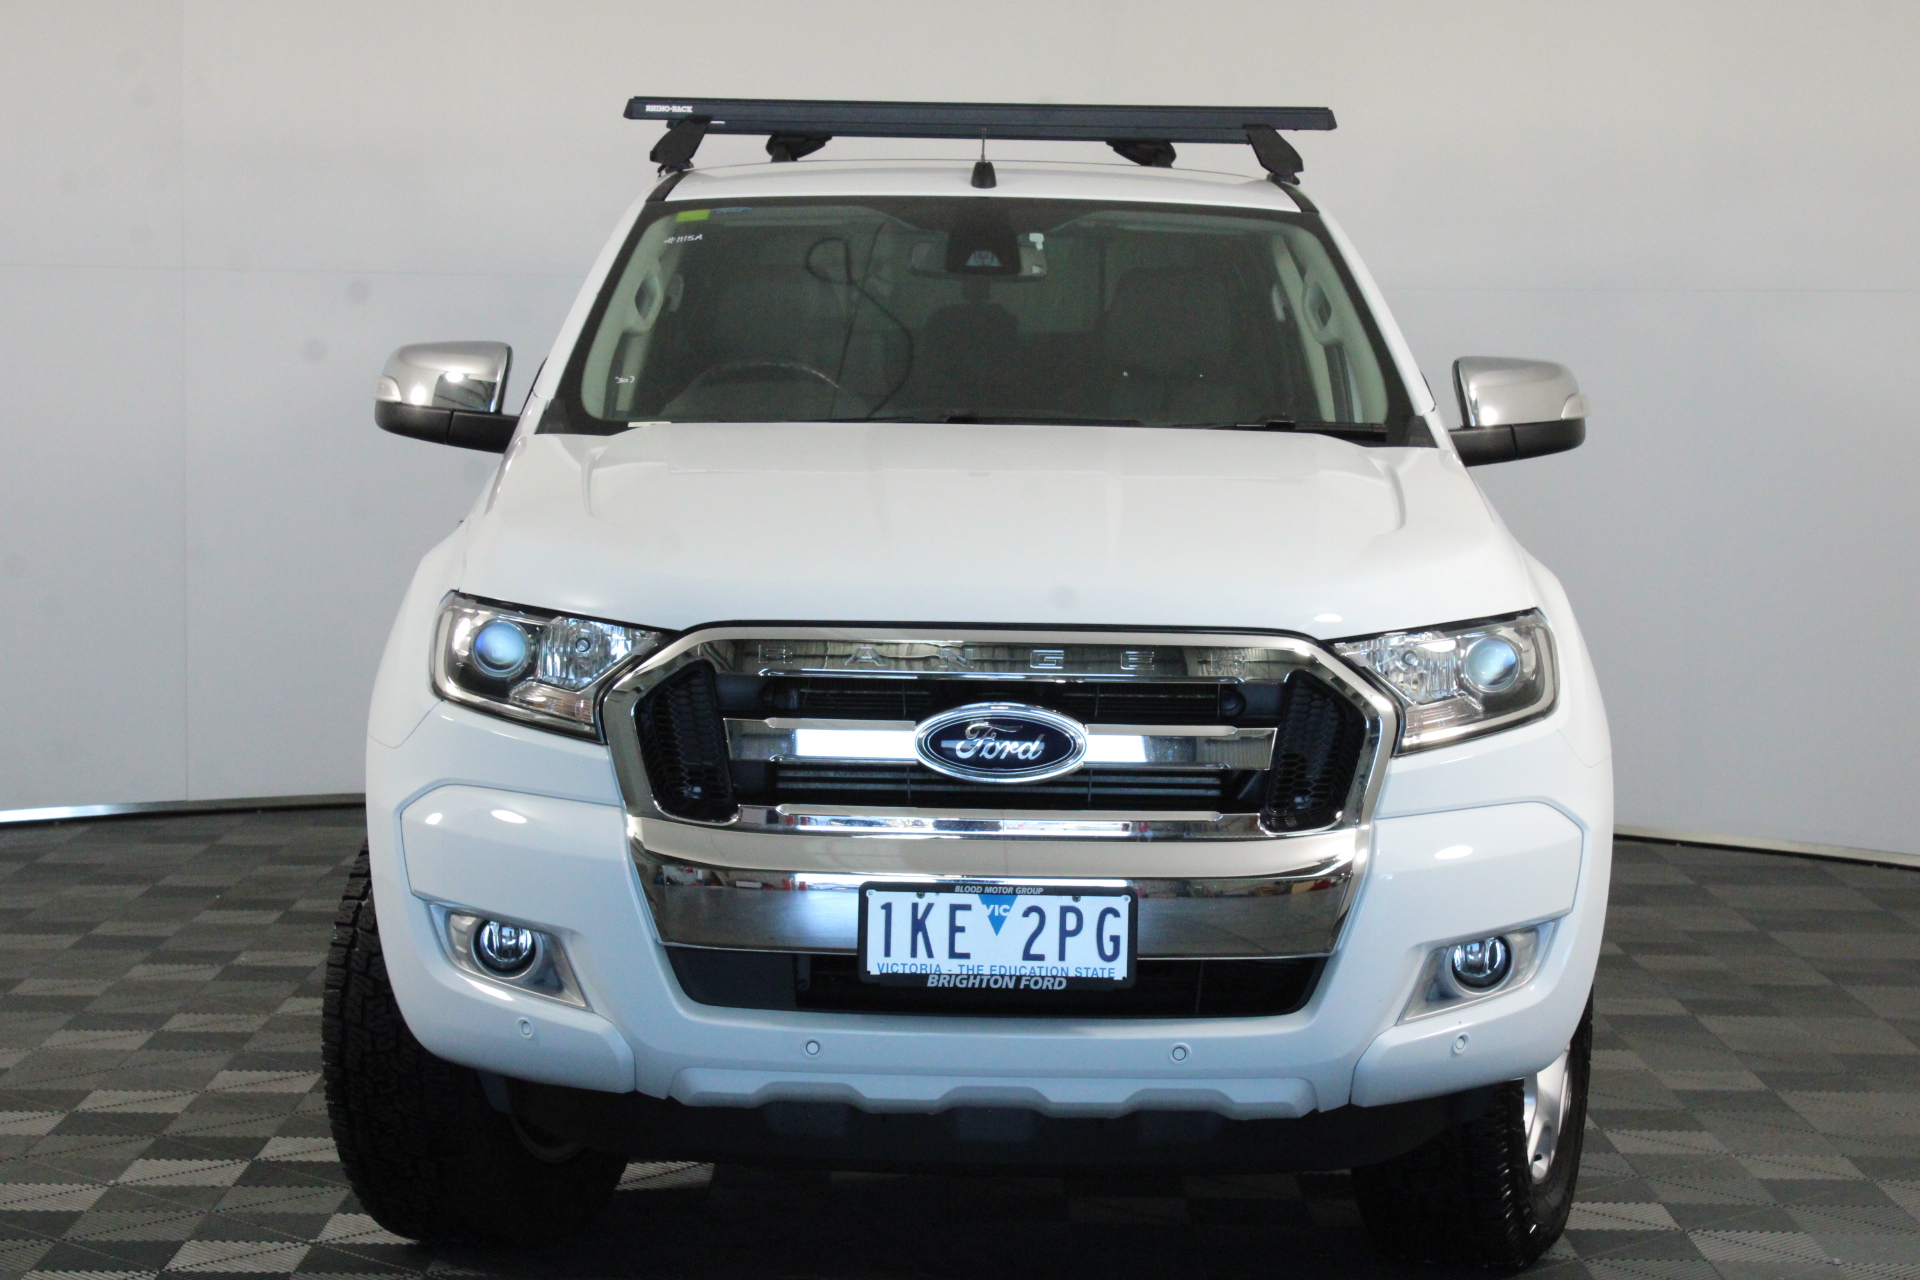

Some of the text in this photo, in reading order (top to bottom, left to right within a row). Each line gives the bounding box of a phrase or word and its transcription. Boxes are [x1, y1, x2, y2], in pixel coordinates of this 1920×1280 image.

[645, 104, 693, 113] RHINO-RACK
[758, 644, 1246, 672] RANGER
[955, 721, 1045, 760] Ford
[954, 885, 1044, 895] BLOOD MOTOR GROUP
[983, 904, 1011, 917] VIC
[880, 901, 1122, 963] 1KE 2PG
[877, 962, 942, 974] VICTORIA
[958, 964, 984, 975] THE
[989, 965, 1070, 977] EDUCATION
[1074, 966, 1116, 979] STATE
[926, 974, 1067, 990] BRIGHTON FORD
